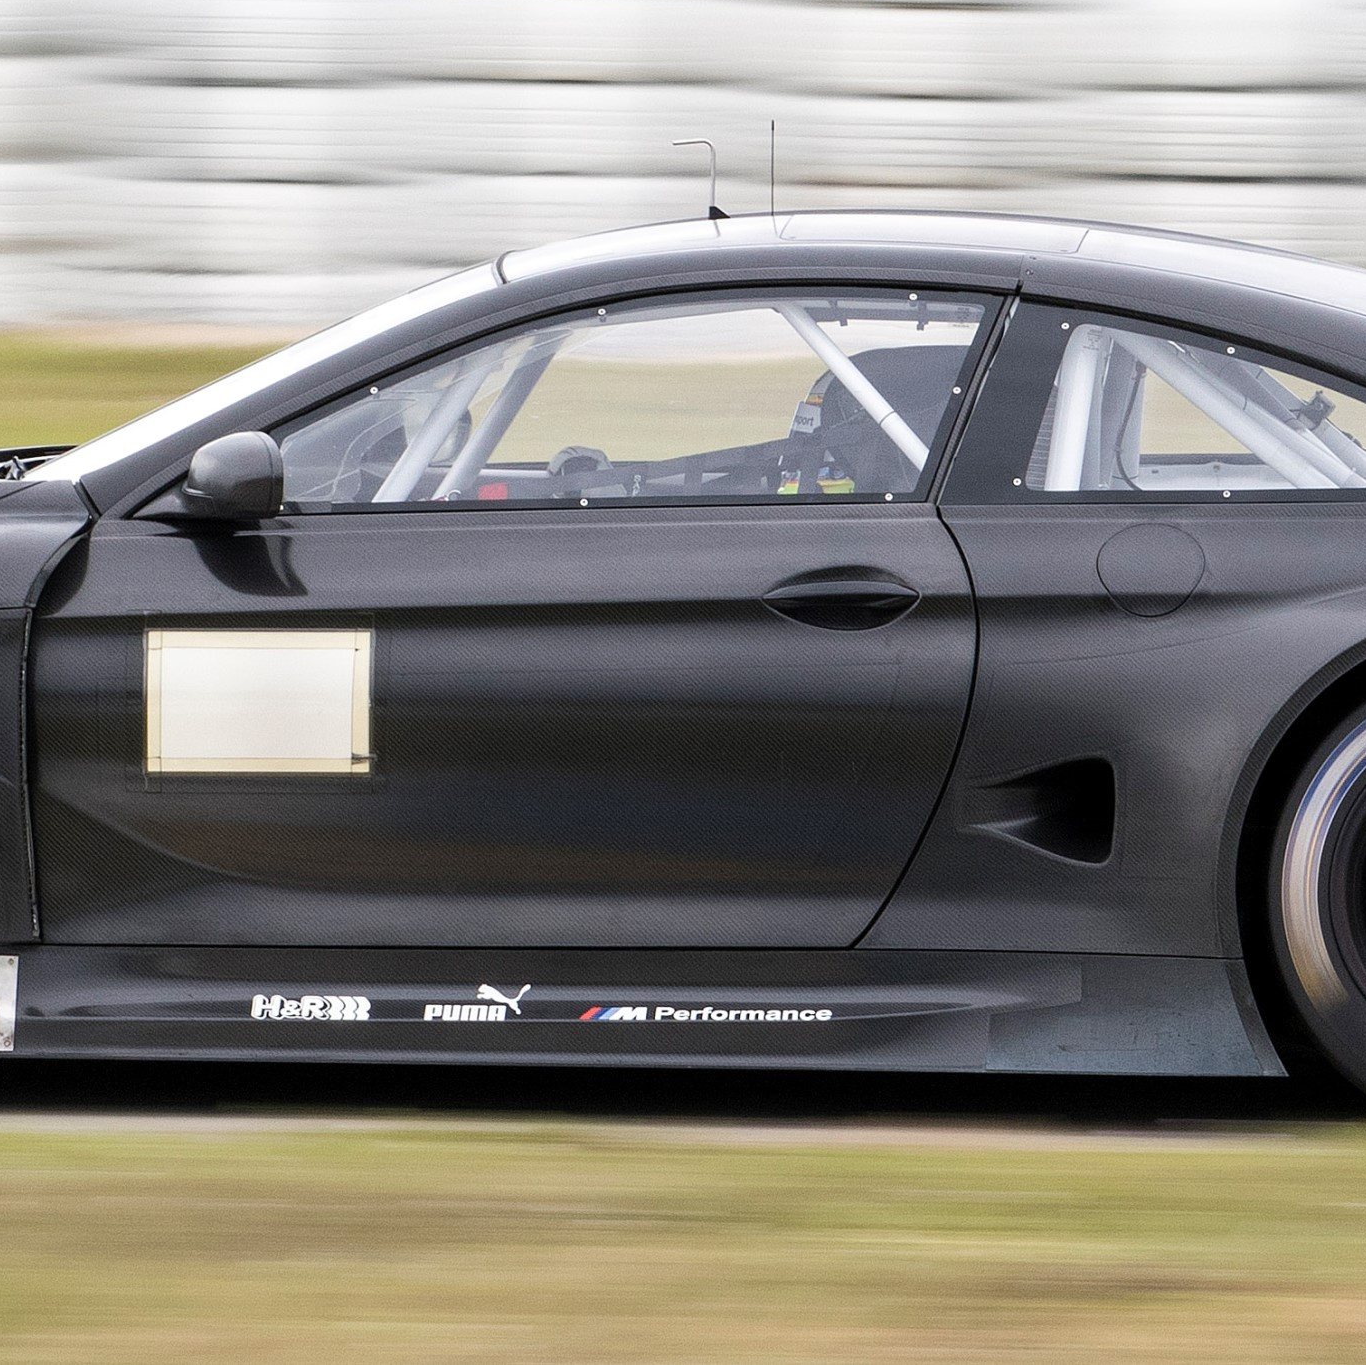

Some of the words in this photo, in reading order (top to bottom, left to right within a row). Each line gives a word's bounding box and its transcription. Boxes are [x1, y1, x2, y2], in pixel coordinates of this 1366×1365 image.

[251, 994, 333, 1020] H&R
[423, 1004, 507, 1021] PUMA
[608, 1006, 648, 1021] M
[654, 1006, 833, 1021] Performance
